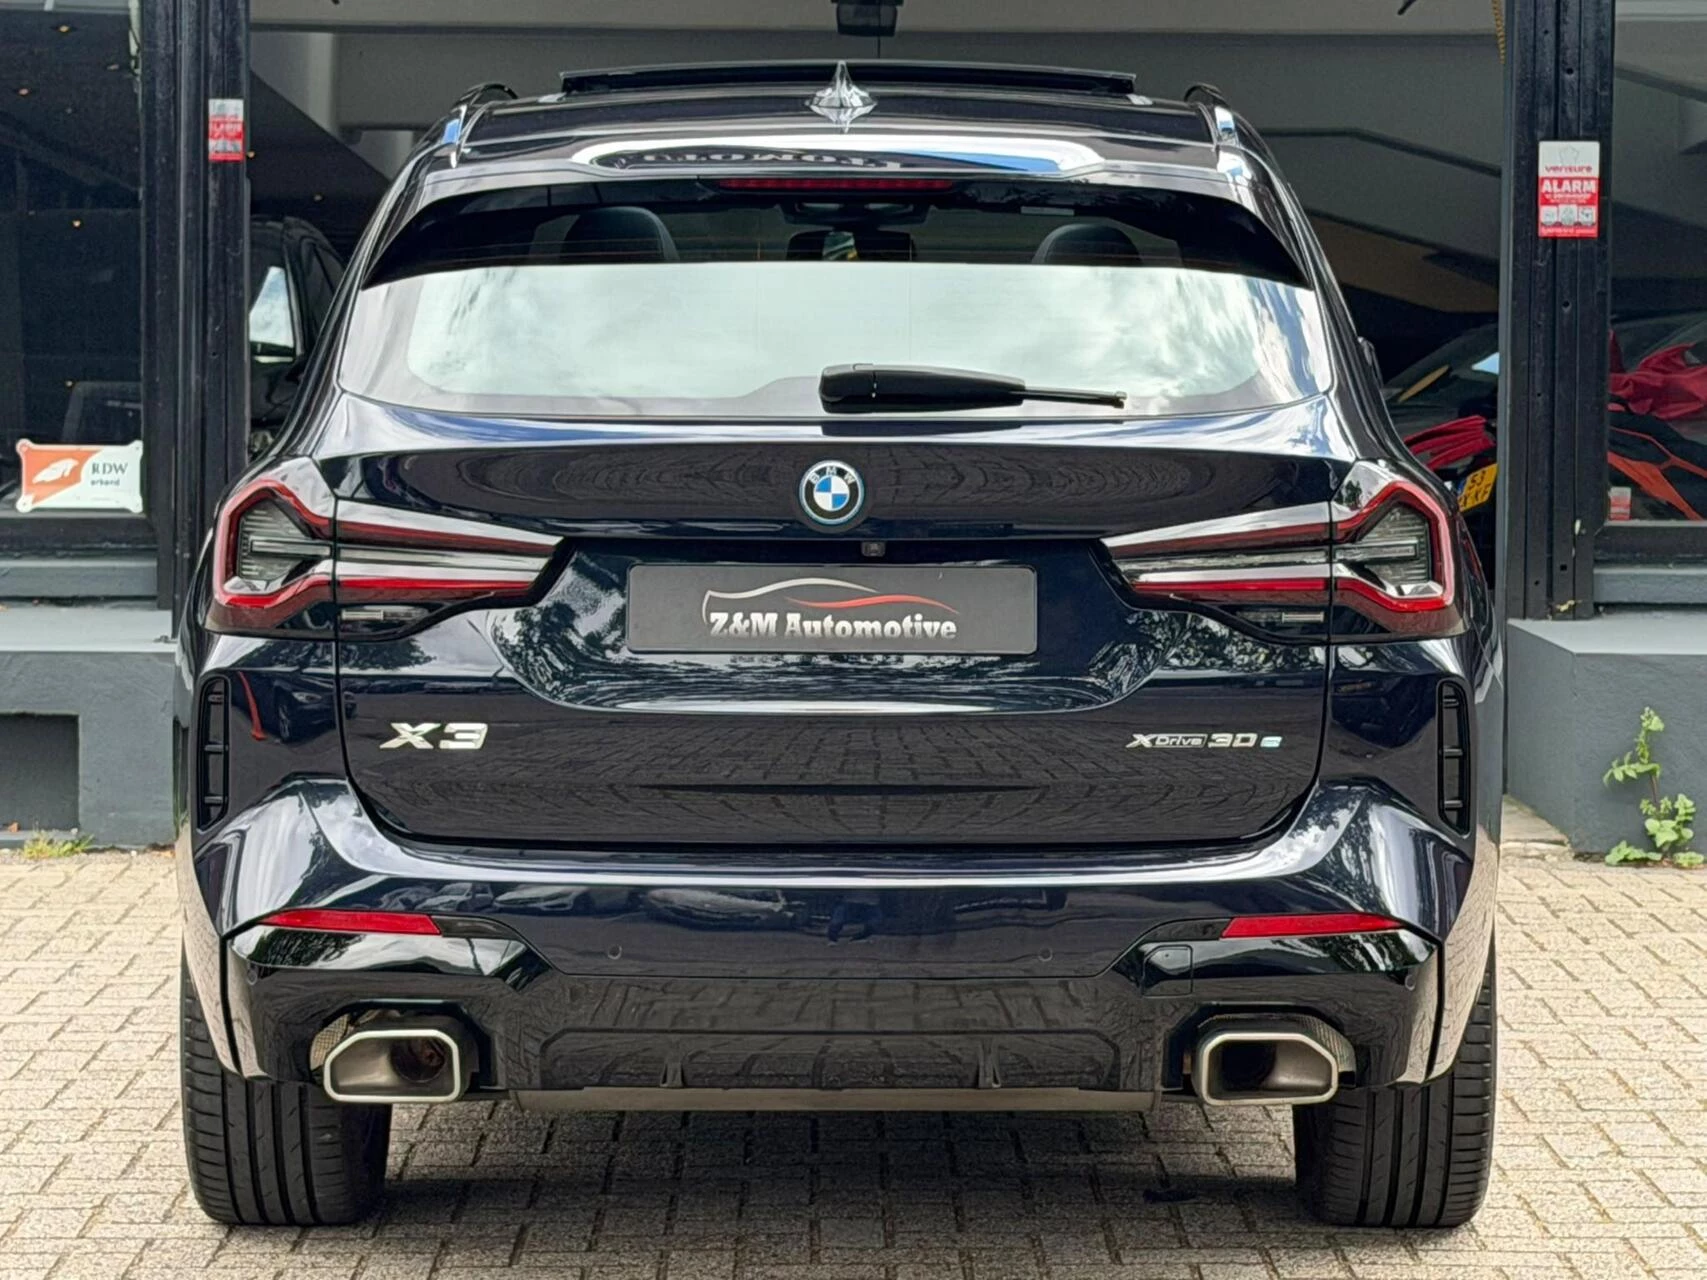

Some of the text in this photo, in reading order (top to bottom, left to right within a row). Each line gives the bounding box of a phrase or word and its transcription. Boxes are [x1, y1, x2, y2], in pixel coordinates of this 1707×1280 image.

[1542, 179, 1596, 194] ALARM
[91, 462, 128, 475] RDW
[807, 465, 857, 485] BMW
[709, 612, 958, 641] Z&M Automotive
[379, 722, 489, 749] X3
